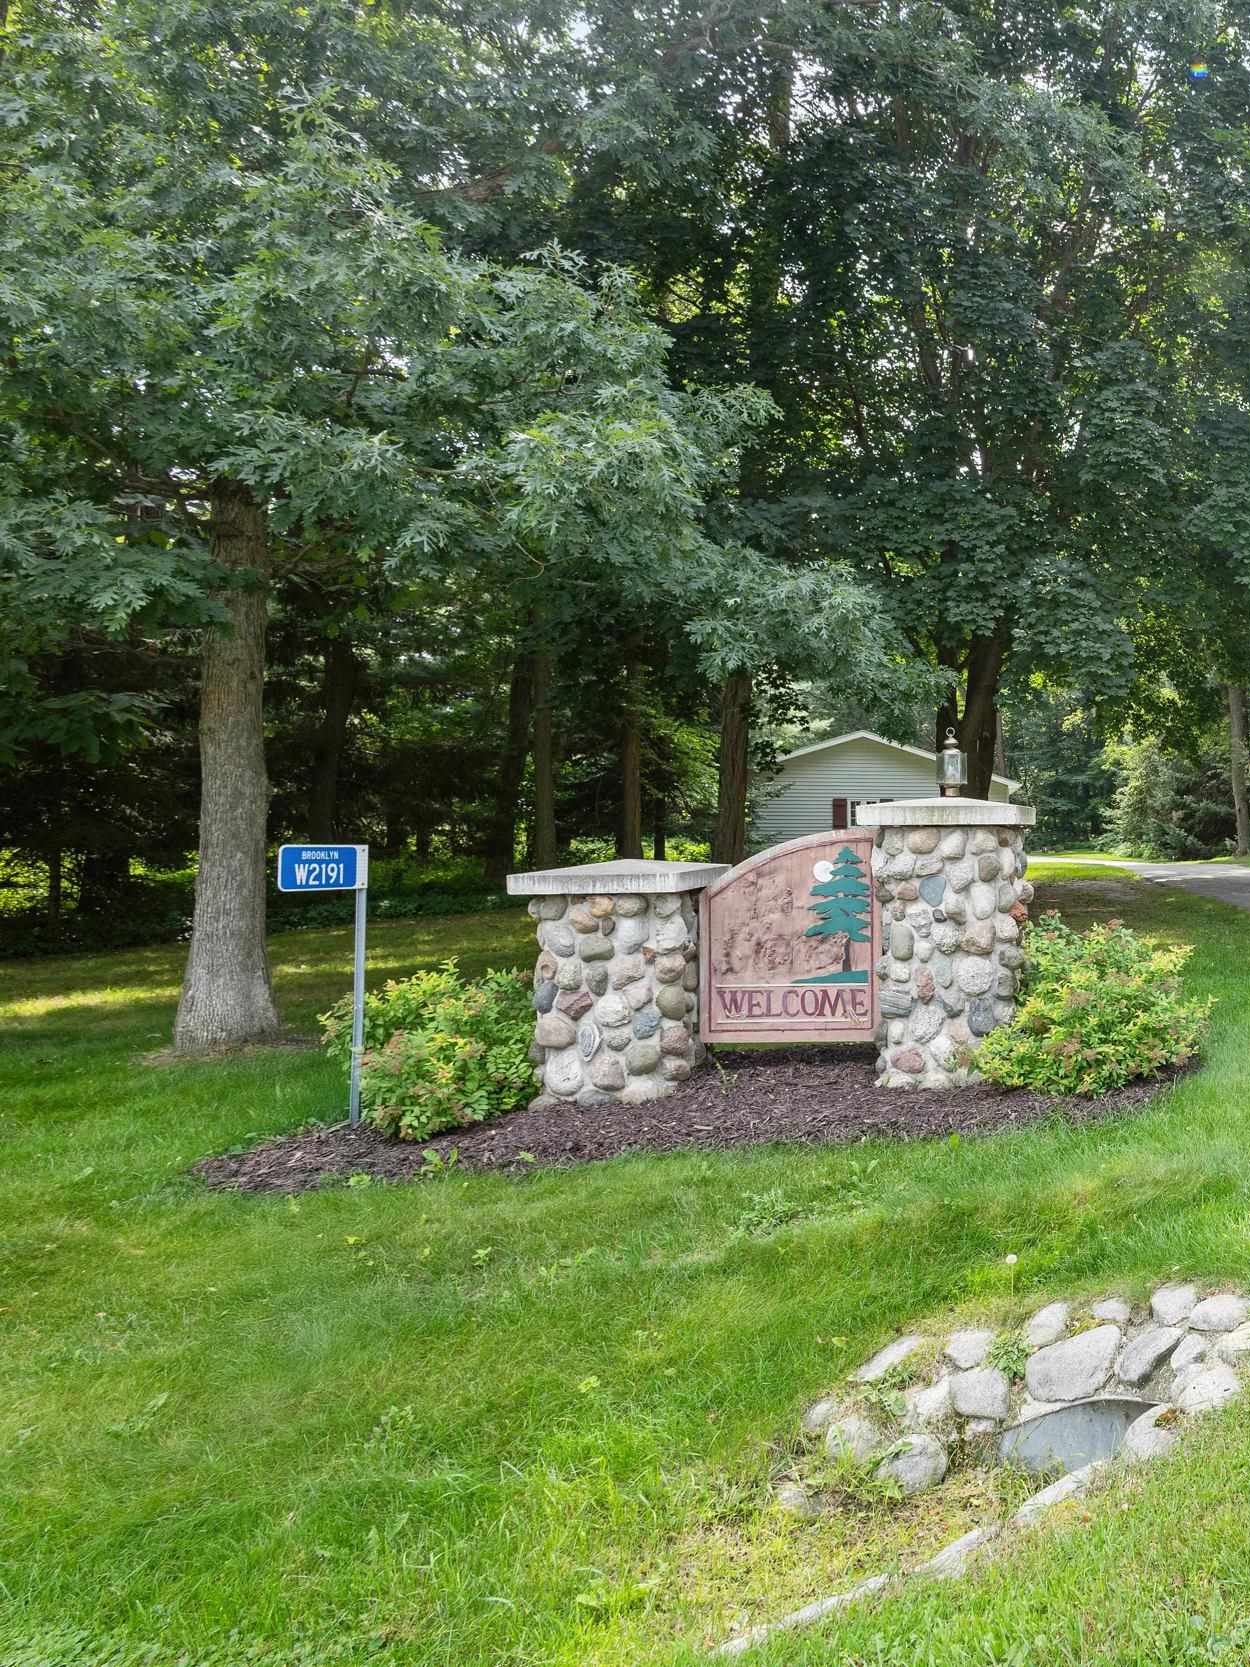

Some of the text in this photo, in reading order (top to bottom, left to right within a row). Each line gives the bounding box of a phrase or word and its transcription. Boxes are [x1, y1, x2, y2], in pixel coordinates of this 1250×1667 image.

[301, 850, 339, 860] BROOKLYN
[294, 863, 344, 886] W2191
[716, 989, 869, 1018] WELCOME
